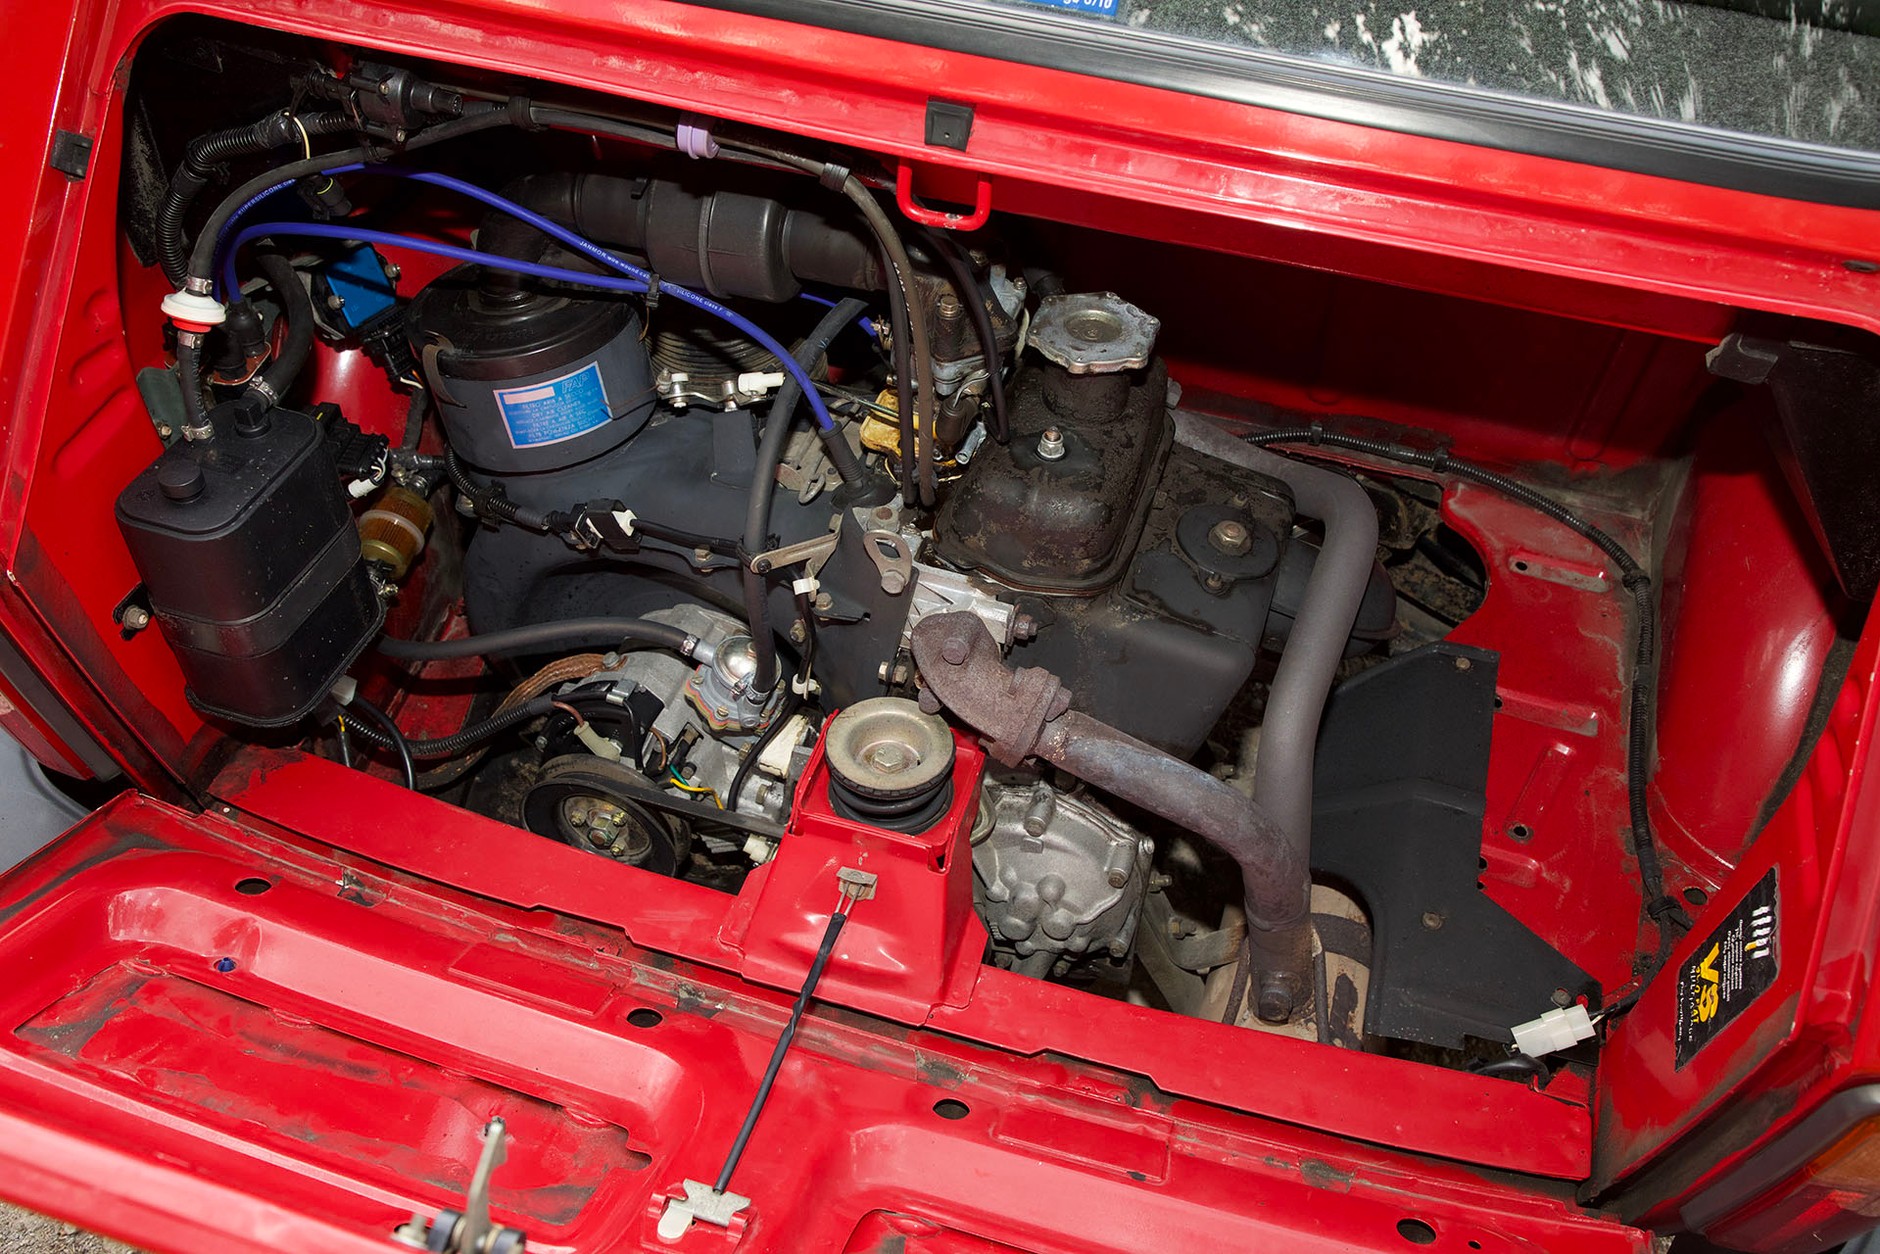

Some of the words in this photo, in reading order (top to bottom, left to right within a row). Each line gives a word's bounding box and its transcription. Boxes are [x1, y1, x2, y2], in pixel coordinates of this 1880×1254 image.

[580, 241, 607, 258] JANMOR
[620, 262, 640, 274] wound
[1699, 942, 1719, 1022] VS
